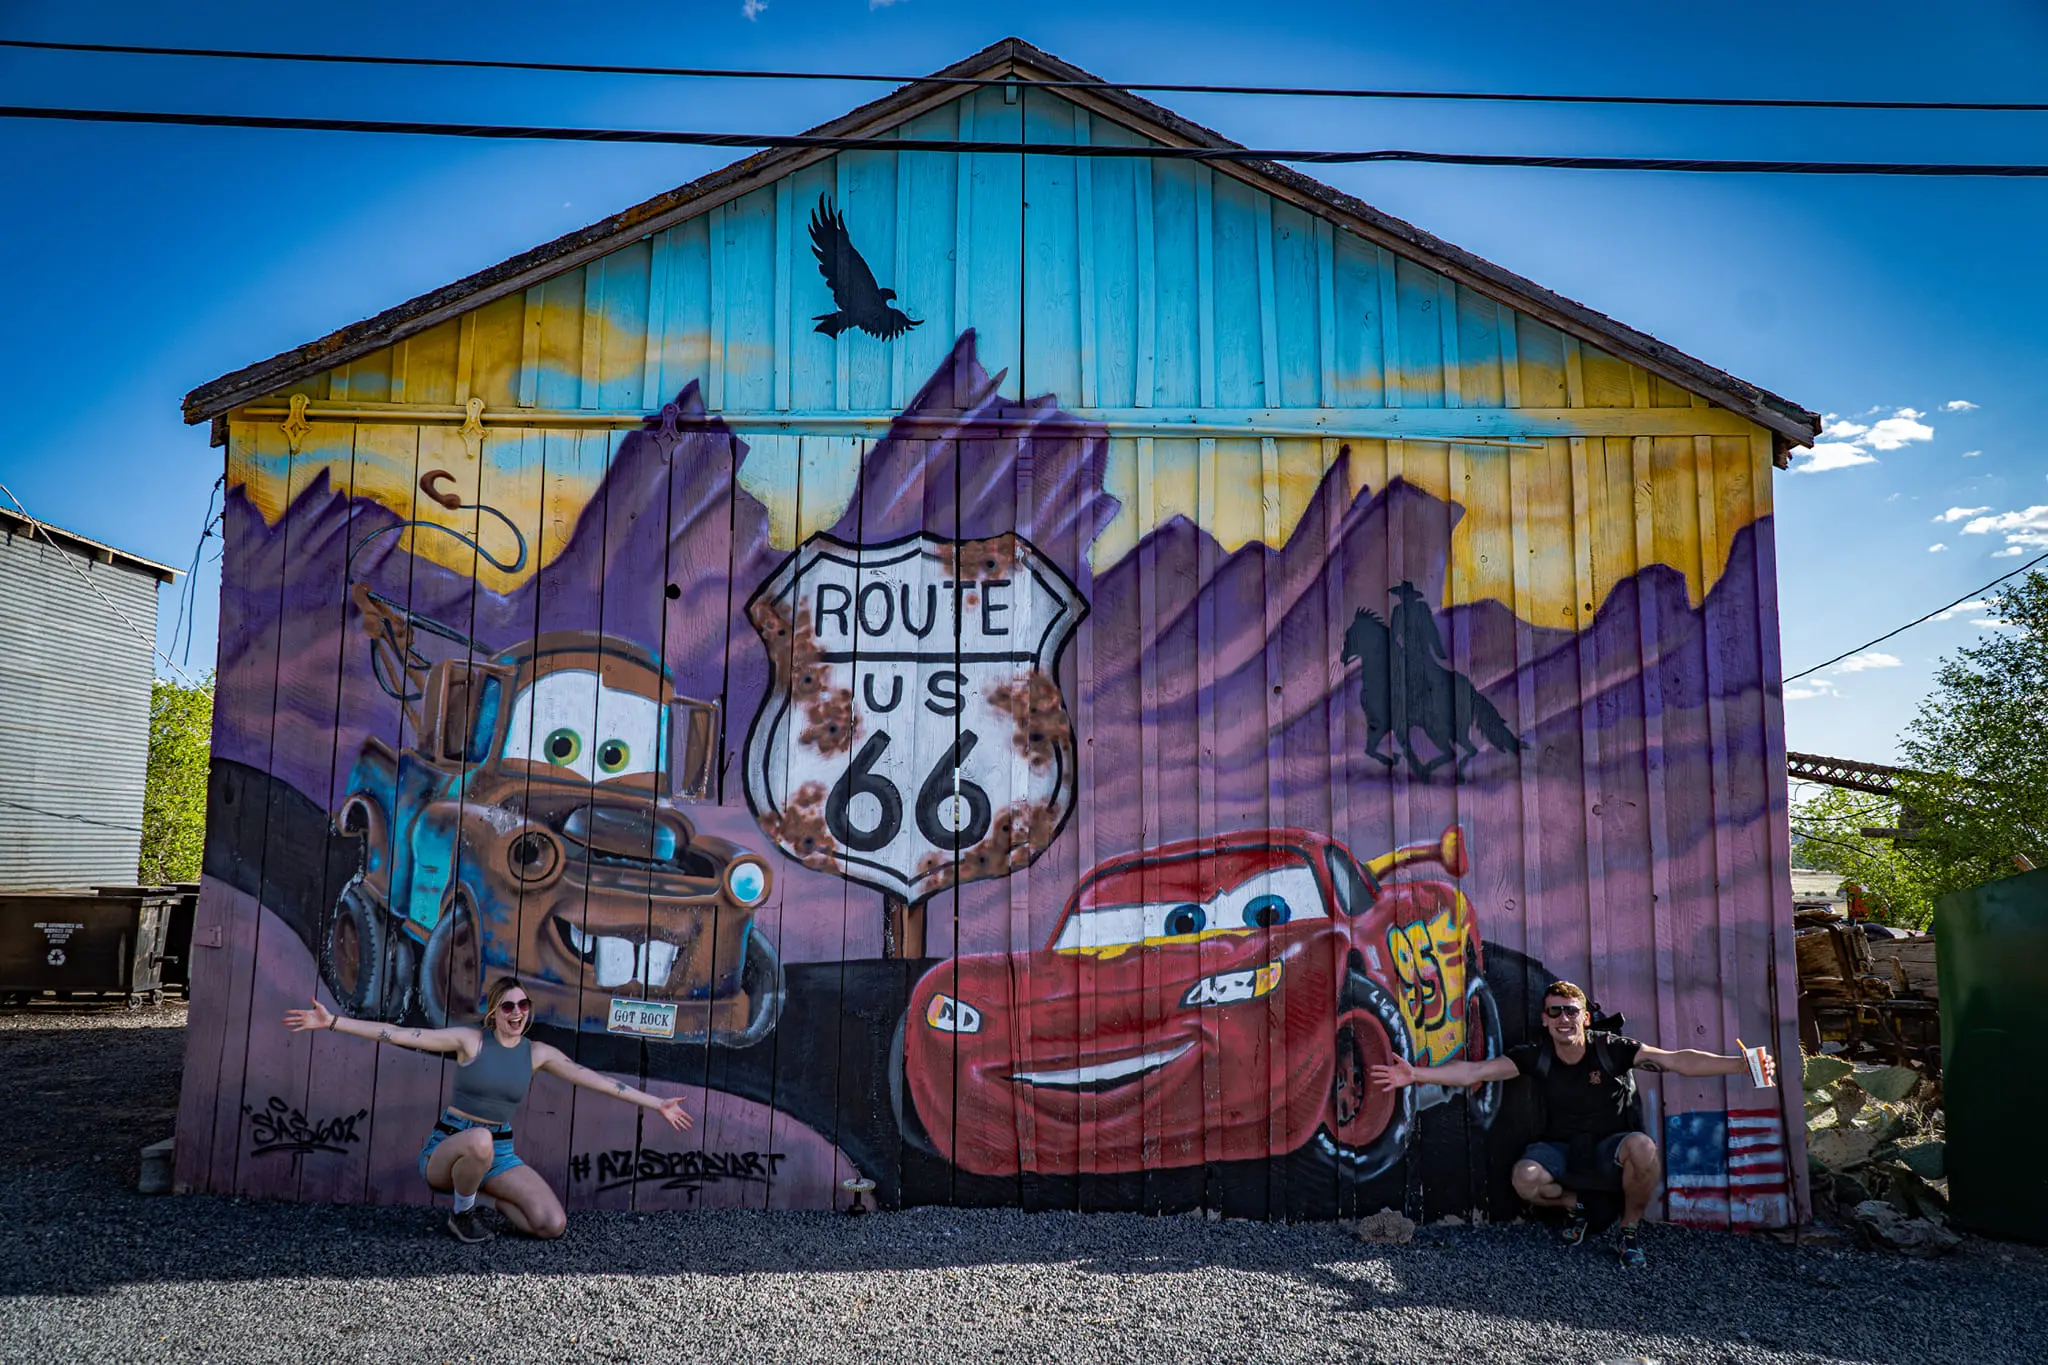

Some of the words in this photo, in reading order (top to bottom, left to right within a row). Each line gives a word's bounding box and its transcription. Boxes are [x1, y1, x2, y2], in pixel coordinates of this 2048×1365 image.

[815, 580, 1011, 639] ROUTE
[825, 729, 991, 850] 66
[614, 1009, 636, 1023] GOT
[640, 1012, 670, 1027] ROCK
